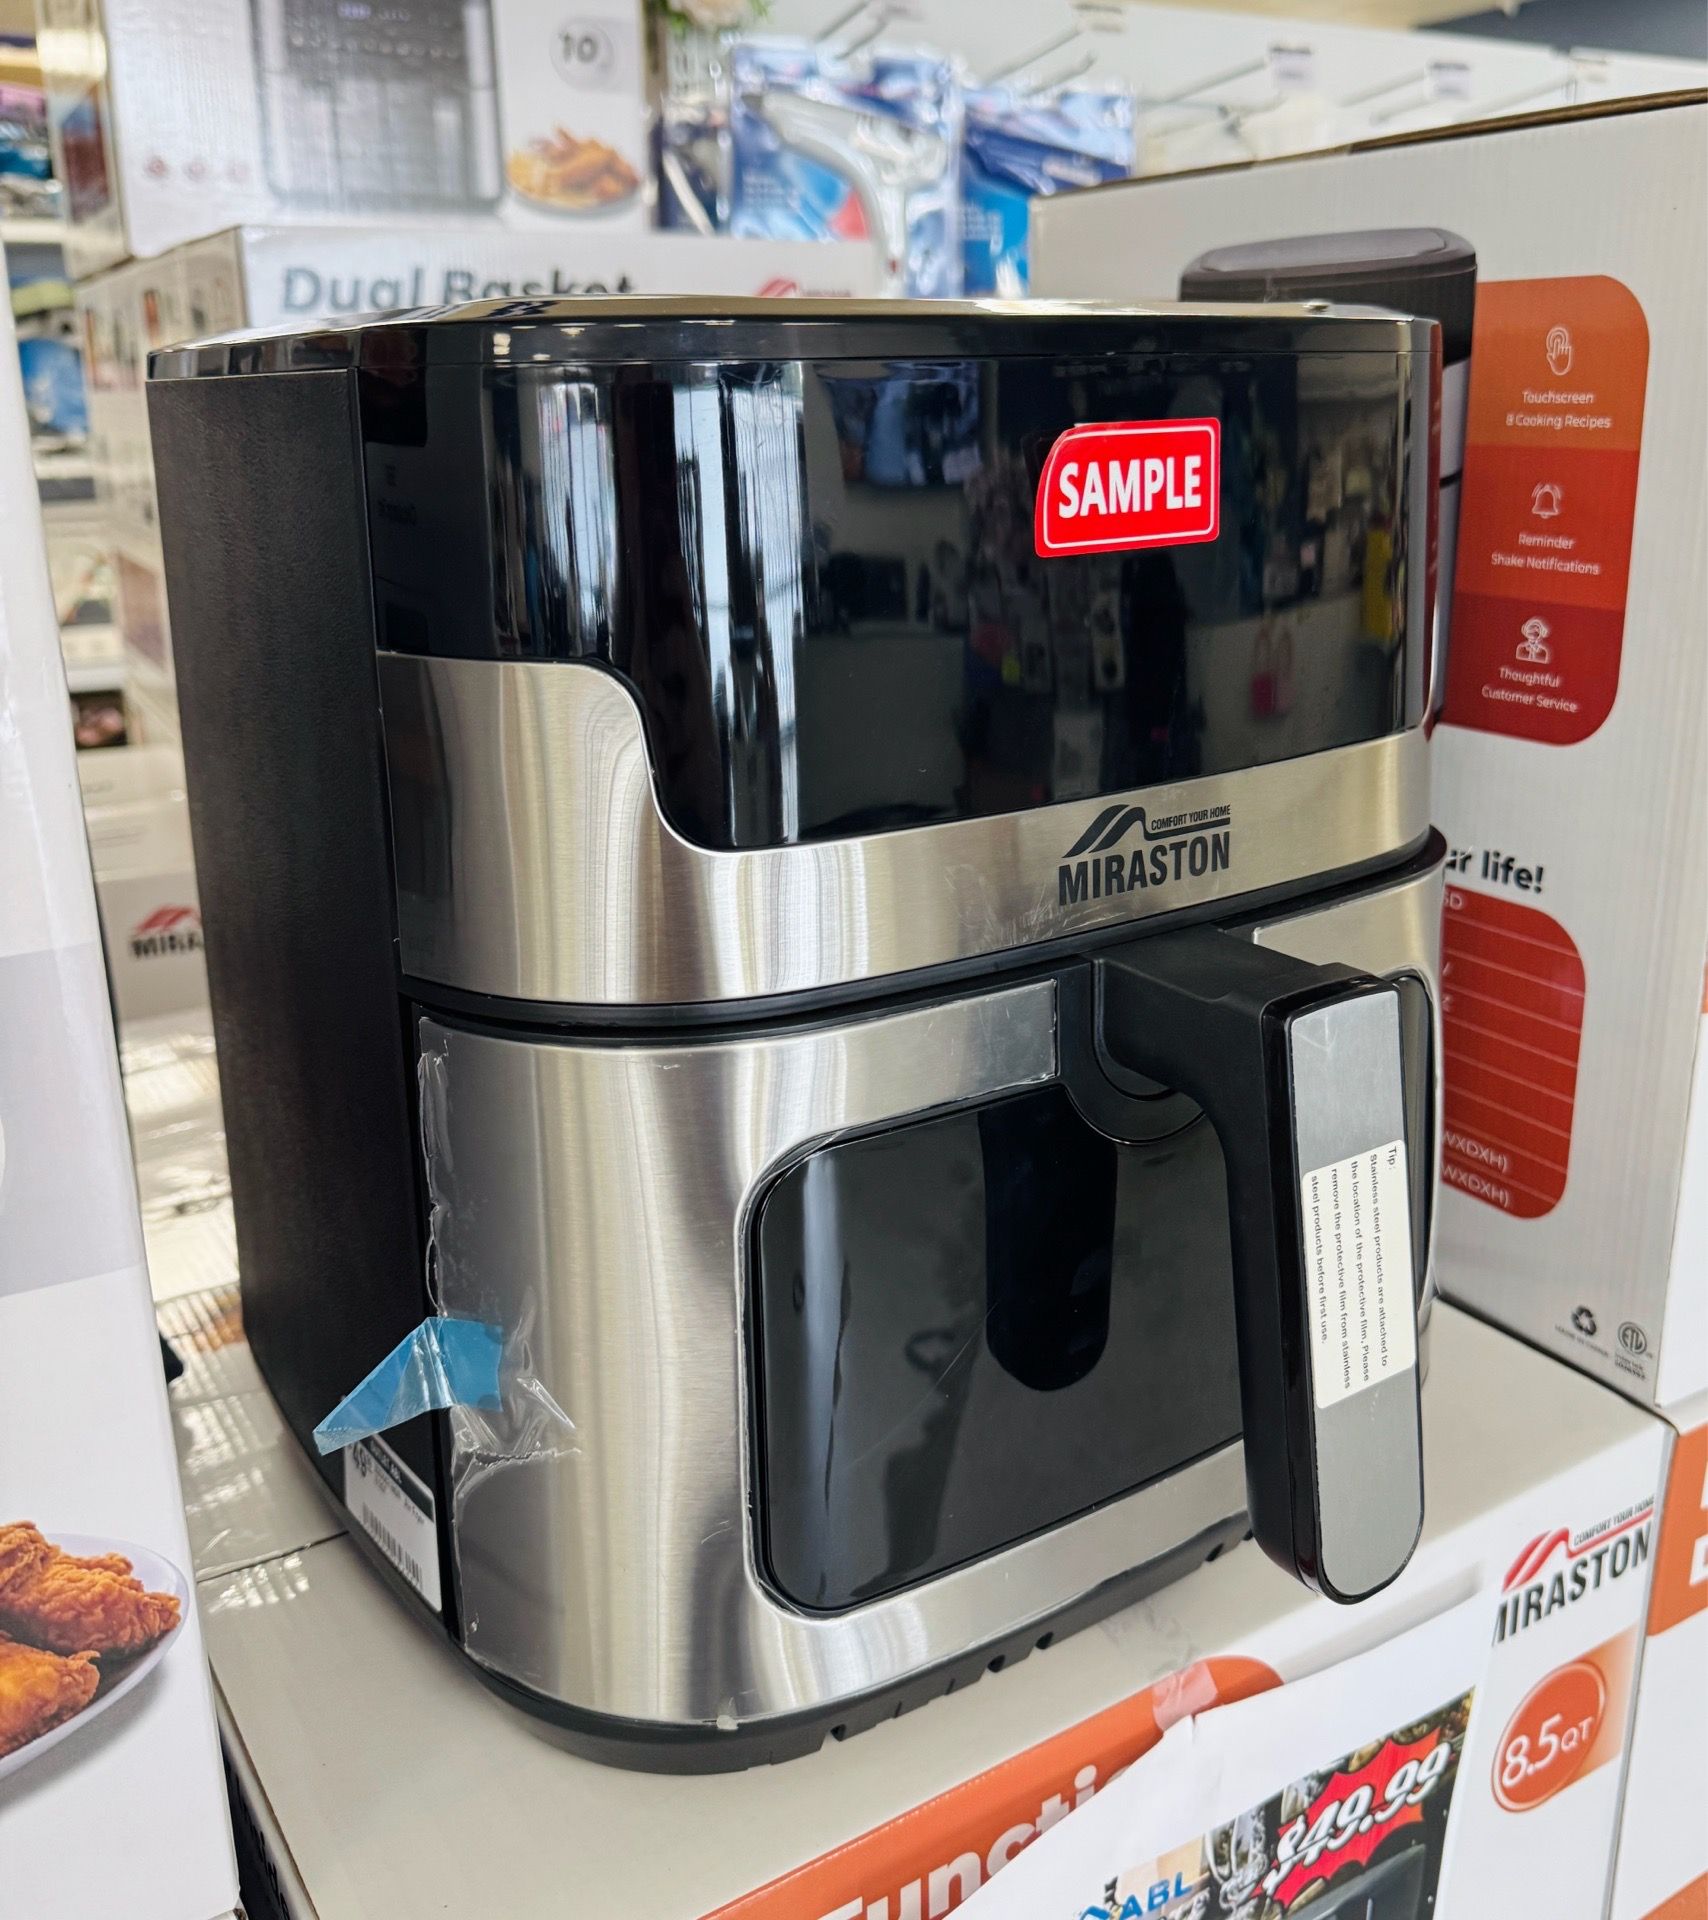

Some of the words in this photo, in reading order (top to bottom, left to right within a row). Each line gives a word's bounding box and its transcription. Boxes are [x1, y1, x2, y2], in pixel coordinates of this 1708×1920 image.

[285, 267, 424, 313] Dual
[1522, 391, 1594, 404] Touchscreen
[1516, 415, 1562, 430] Cooking
[1565, 415, 1611, 430] Recipes
[1058, 455, 1202, 519] SAMPLE
[1519, 533, 1575, 549] Reminder
[1492, 553, 1526, 568] Shake
[1527, 556, 1601, 575] Notifications
[1500, 667, 1561, 688] Thoughtful
[1482, 686, 1534, 705] Customer
[1537, 695, 1579, 713] Service
[1151, 813, 1188, 831] COMFORT
[1189, 809, 1209, 824] YOUR
[1209, 804, 1231, 820] HOME
[1058, 831, 1230, 906] MIRASTON
[1482, 850, 1543, 893] life!
[1312, 1176, 1320, 1203] steel
[1370, 1154, 1378, 1204] Stainless
[1352, 1181, 1360, 1226] location
[1373, 1207, 1381, 1233] steel
[1312, 1206, 1323, 1255] products
[1355, 1228, 1362, 1238] of
[1374, 1236, 1384, 1284] products
[1356, 1263, 1366, 1317] protective
[1335, 1233, 1344, 1288] protective
[1342, 1341, 1350, 1389] stainless
[1379, 1307, 1388, 1352] attached
[1382, 1354, 1388, 1366] to
[1574, 1518, 1611, 1546] COMFORT
[1613, 1506, 1633, 1525] YOUR
[1261, 1741, 1450, 1898] $49.99
